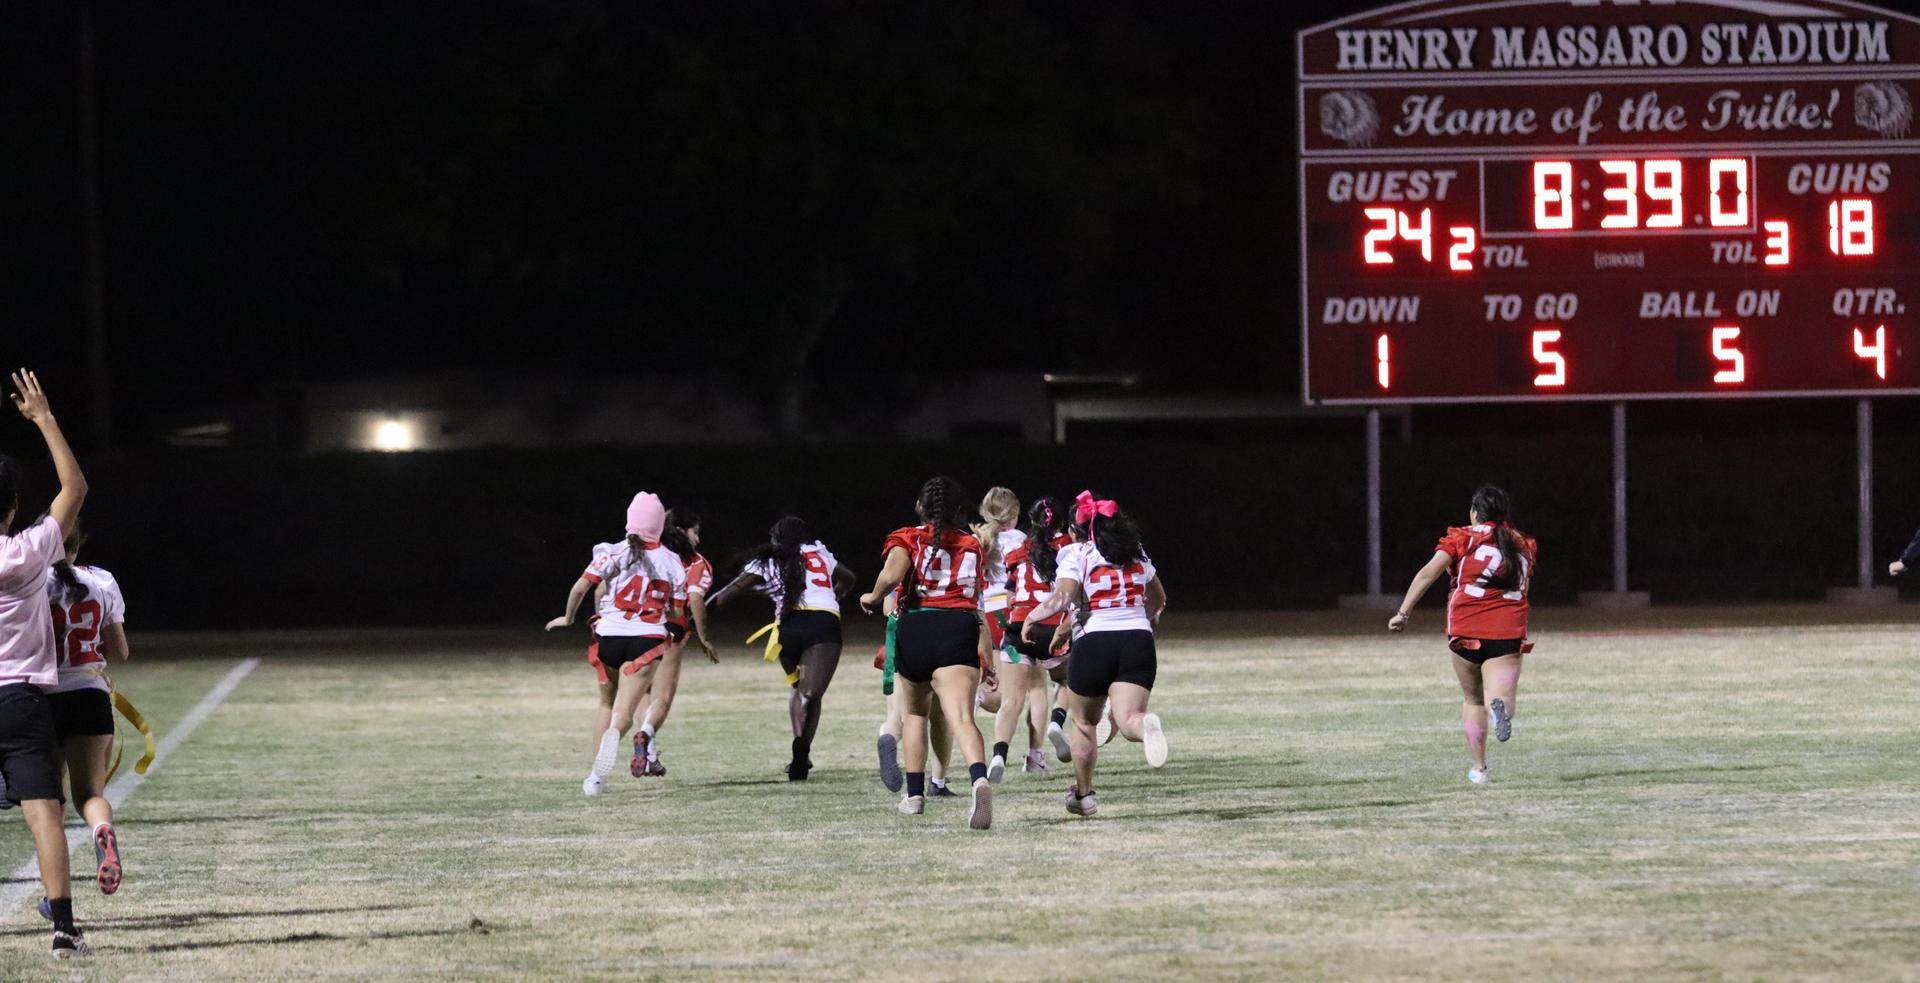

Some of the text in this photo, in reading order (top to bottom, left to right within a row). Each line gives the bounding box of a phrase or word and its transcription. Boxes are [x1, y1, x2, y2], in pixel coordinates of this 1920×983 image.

[1336, 21, 1891, 70] HENRY MASSARO STADIUM
[1393, 88, 1840, 146] Home of the Tribe!
[1327, 170, 1457, 202] GUEST
[1788, 161, 1891, 195] CUHS
[1363, 207, 1432, 264] 24
[1449, 226, 1475, 271] 2
[1763, 220, 1790, 265] 3
[1828, 199, 1875, 257] 18
[1481, 245, 1529, 268] TOL
[1711, 241, 1758, 264] TOL
[1322, 296, 1420, 324] DOWN
[1484, 293, 1579, 321] TO GO
[1639, 289, 1781, 319] BALL ON
[1832, 287, 1906, 316] QTR.
[1377, 333, 1390, 389] 1
[1532, 329, 1567, 387] 5
[1711, 326, 1746, 384] 5
[1853, 323, 1887, 381] 4
[921, 545, 977, 598] 94
